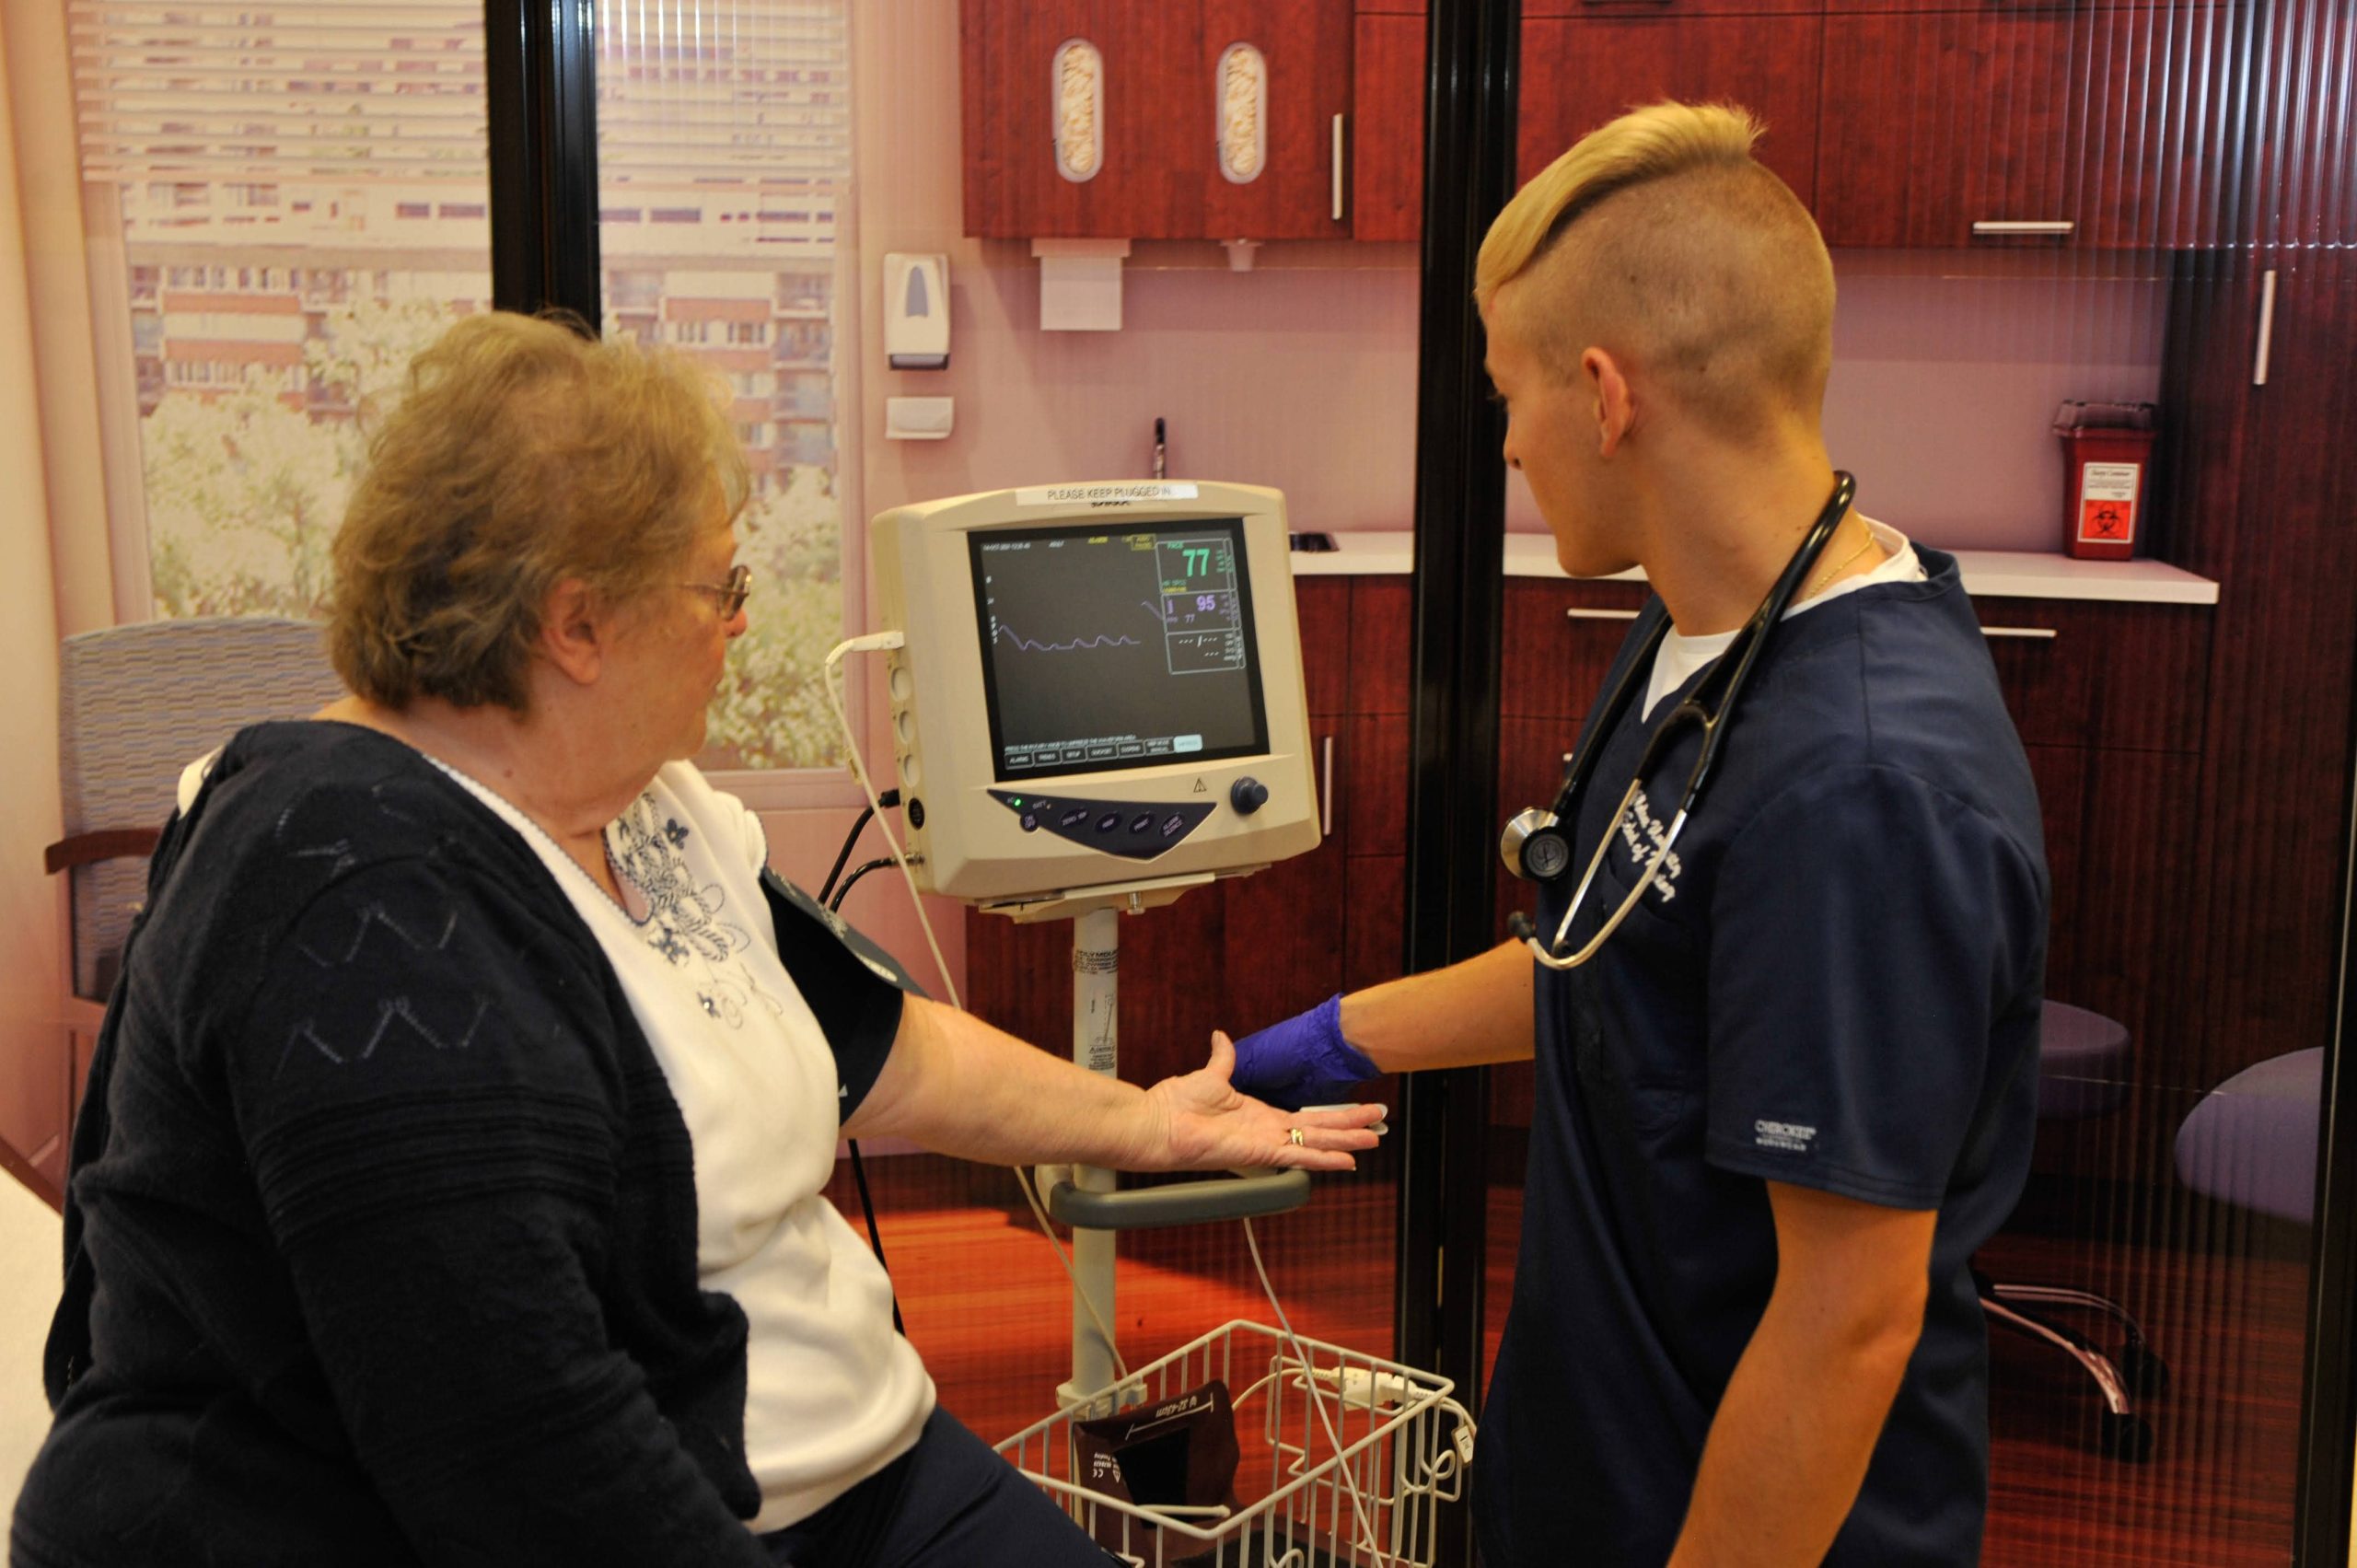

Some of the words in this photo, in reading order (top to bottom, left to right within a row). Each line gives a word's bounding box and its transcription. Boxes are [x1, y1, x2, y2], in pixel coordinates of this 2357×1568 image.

[1047, 489, 1085, 500] PLEASE
[1087, 488, 1112, 498] KEEP
[1114, 486, 1159, 497] PLUGGED
[1182, 548, 1210, 577] 77
[1196, 594, 1215, 611] 95
[1184, 614, 1195, 623] 77
